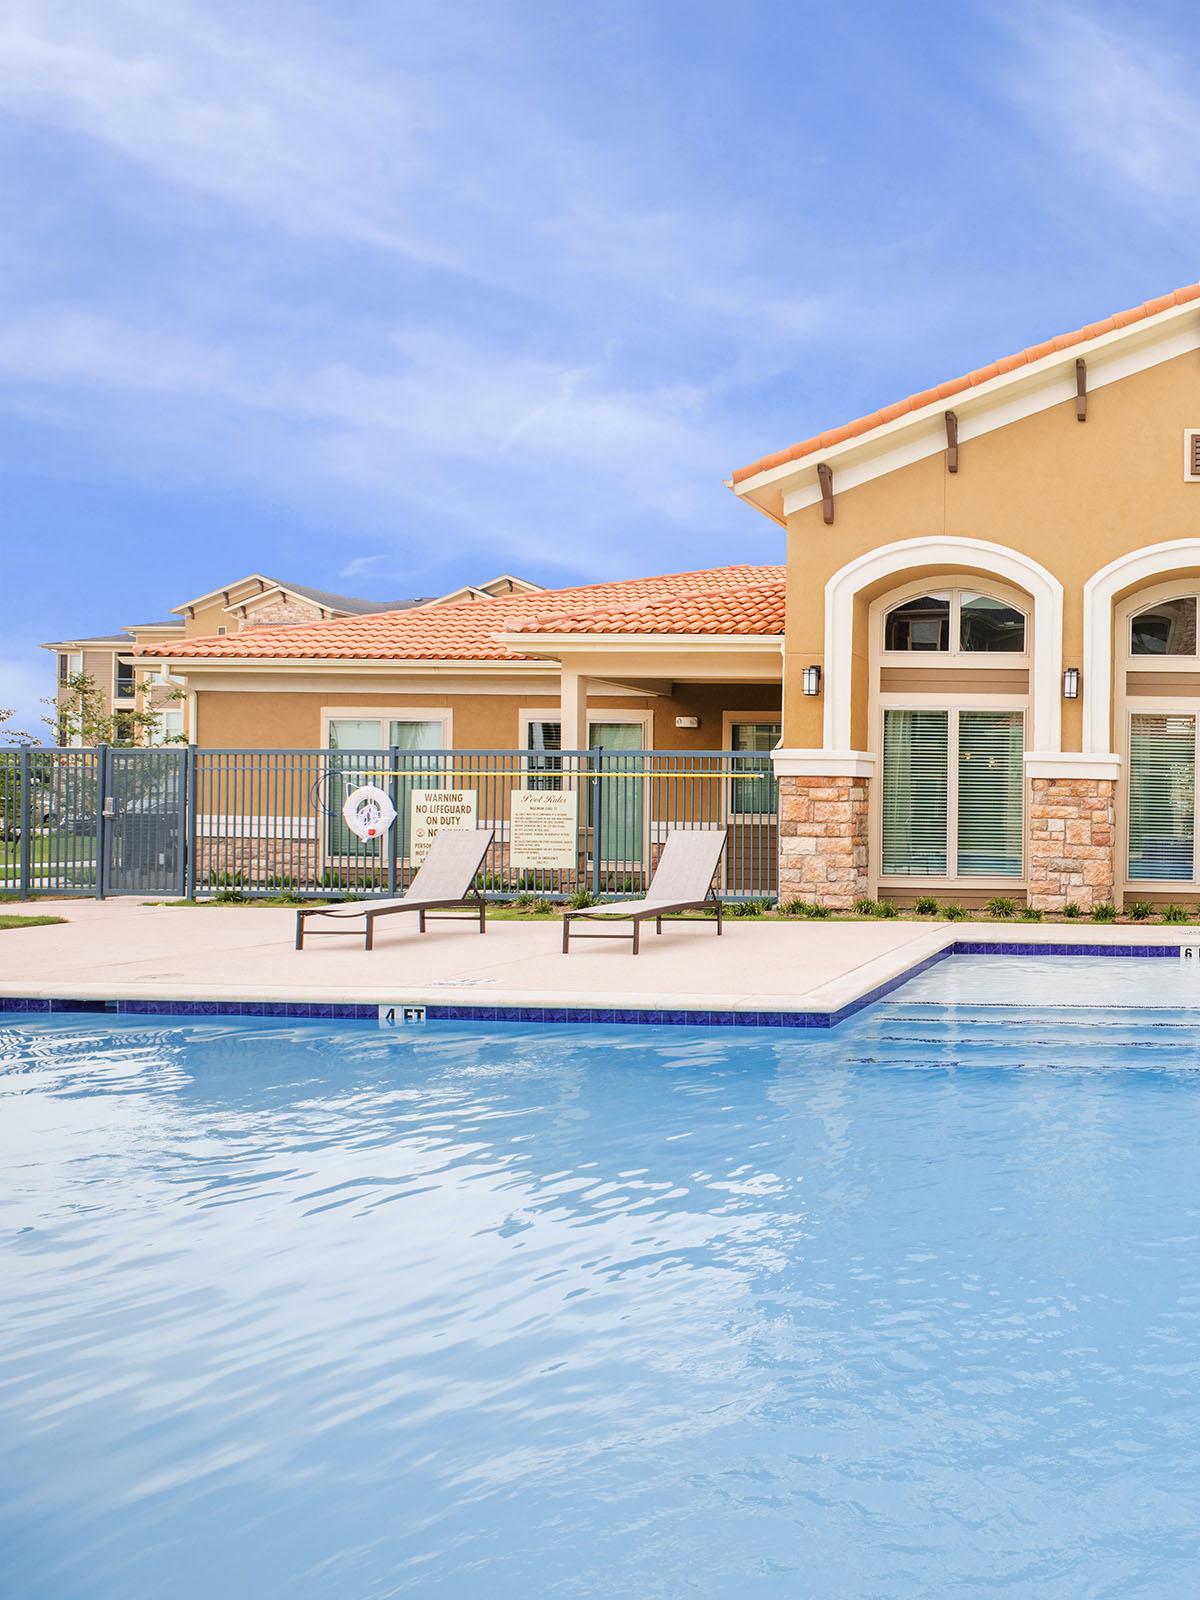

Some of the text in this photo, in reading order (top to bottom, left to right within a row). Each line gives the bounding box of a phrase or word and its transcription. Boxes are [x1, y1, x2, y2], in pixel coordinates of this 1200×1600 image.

[424, 793, 464, 803] WARNING
[520, 793, 567, 804] Pool Rules
[415, 804, 472, 814] NO LIFEGUARD
[425, 816, 461, 825] ON DUTY
[1184, 947, 1193, 958] 6
[403, 1008, 425, 1021] FT
